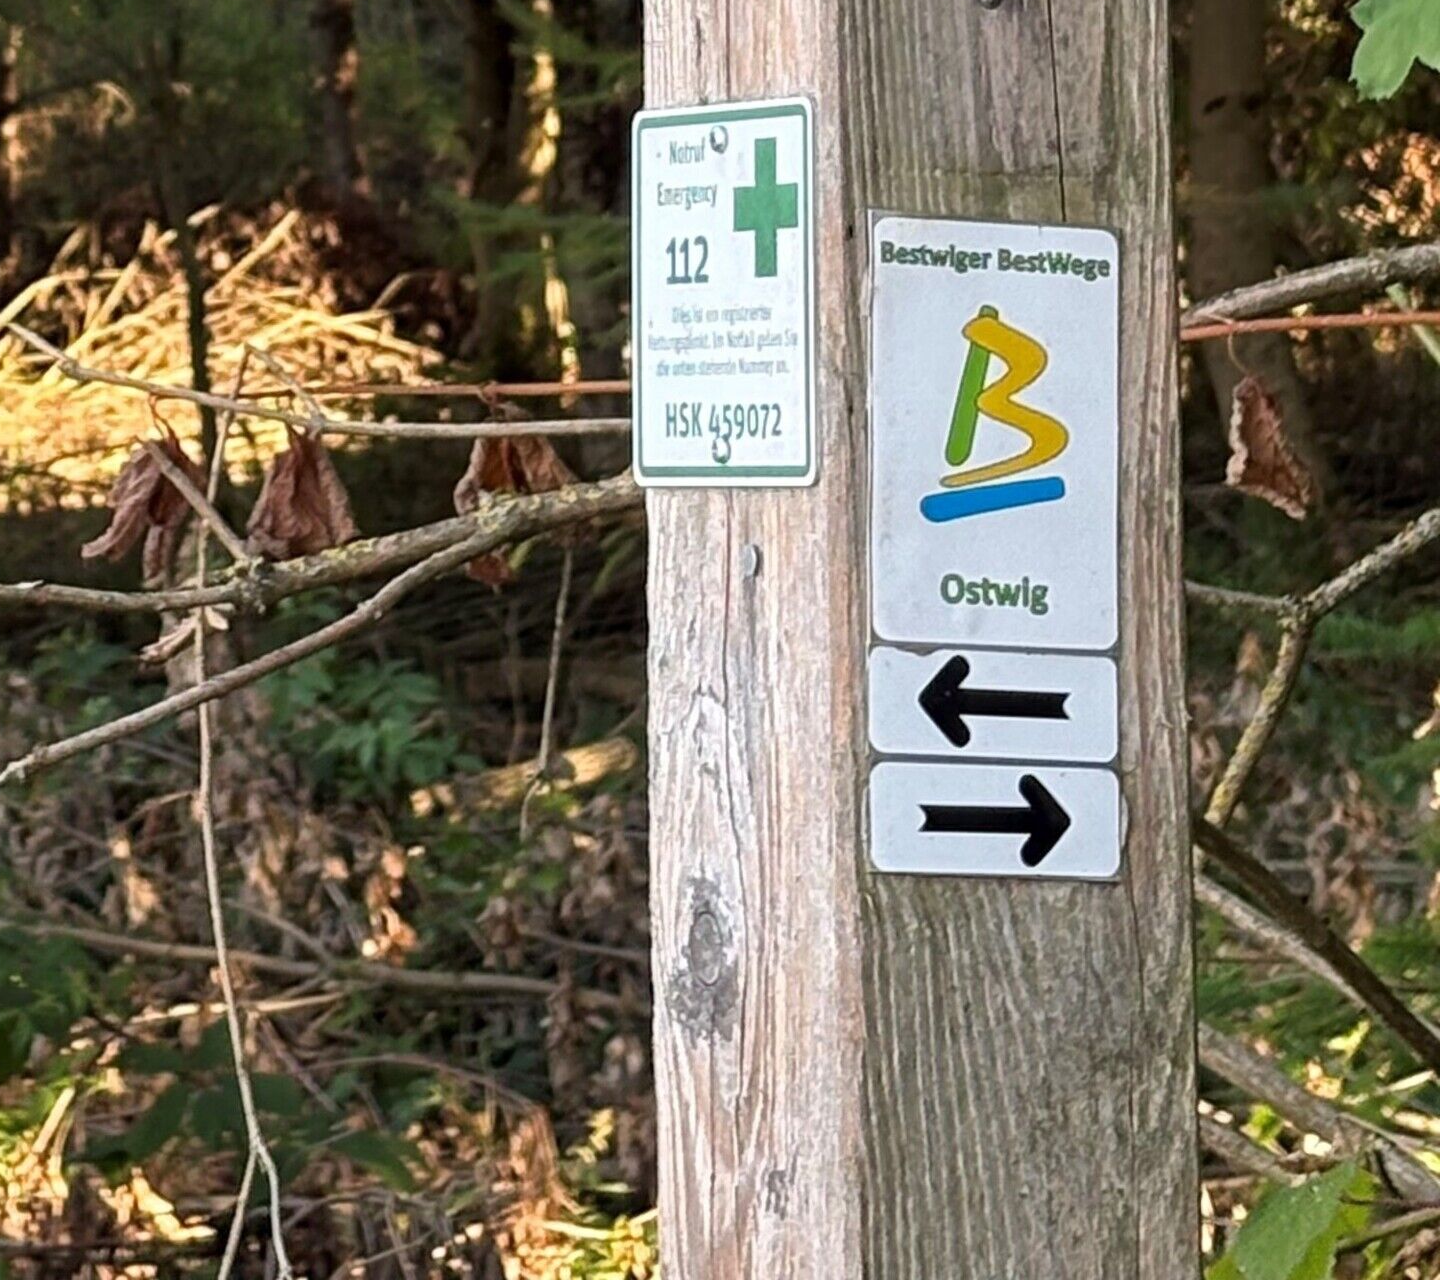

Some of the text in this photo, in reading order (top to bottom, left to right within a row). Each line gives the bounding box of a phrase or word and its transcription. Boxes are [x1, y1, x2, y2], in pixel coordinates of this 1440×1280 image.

[657, 182, 718, 211] Emergency
[665, 235, 710, 285] 112
[880, 240, 1112, 282] Bestwiger BestWege
[665, 402, 783, 440] HSK 459072
[939, 573, 1050, 616] Ostwig
